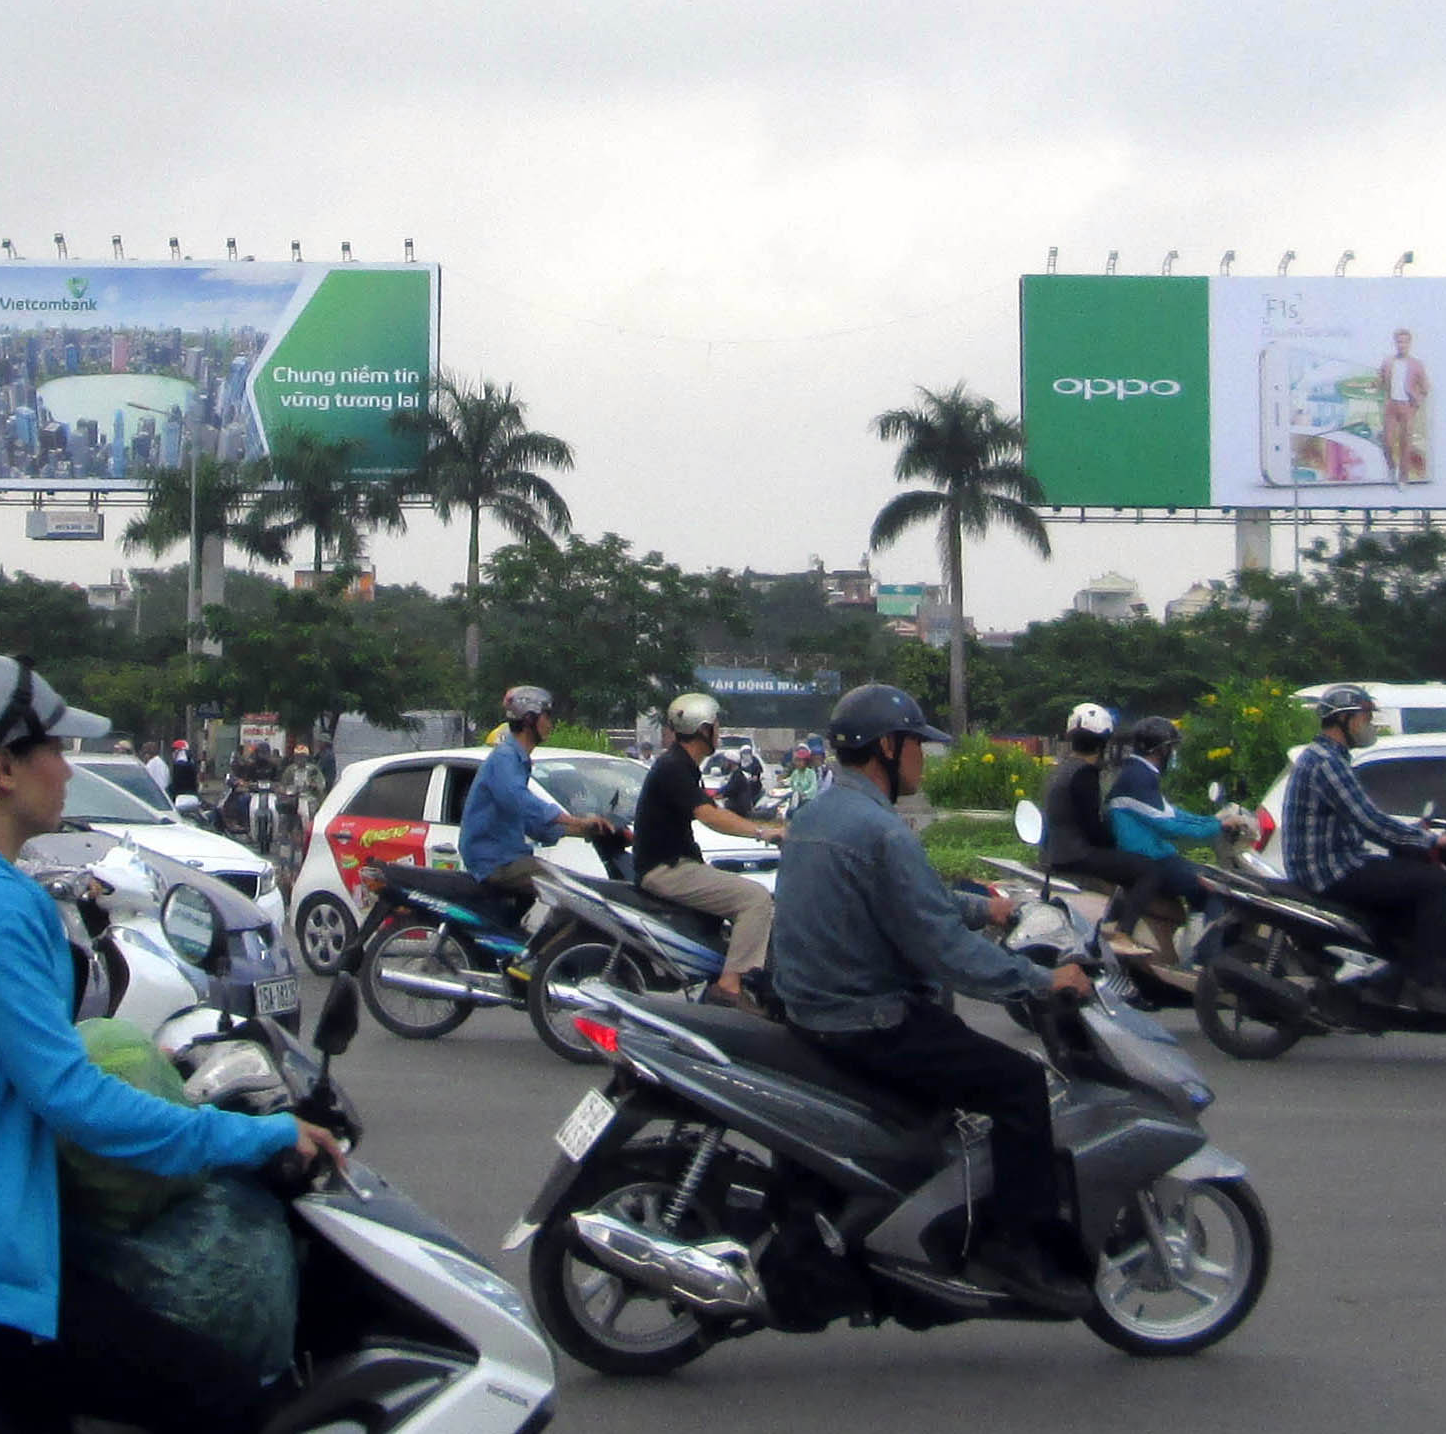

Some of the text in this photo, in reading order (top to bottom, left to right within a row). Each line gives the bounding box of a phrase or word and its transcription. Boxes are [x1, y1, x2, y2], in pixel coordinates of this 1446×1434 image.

[0, 297, 98, 310] Vietcombank
[1266, 299, 1298, 318] F1s
[273, 365, 419, 386] Chung niềm tin
[1053, 378, 1181, 400] oppo
[280, 391, 330, 410] vững
[398, 392, 419, 408] lai
